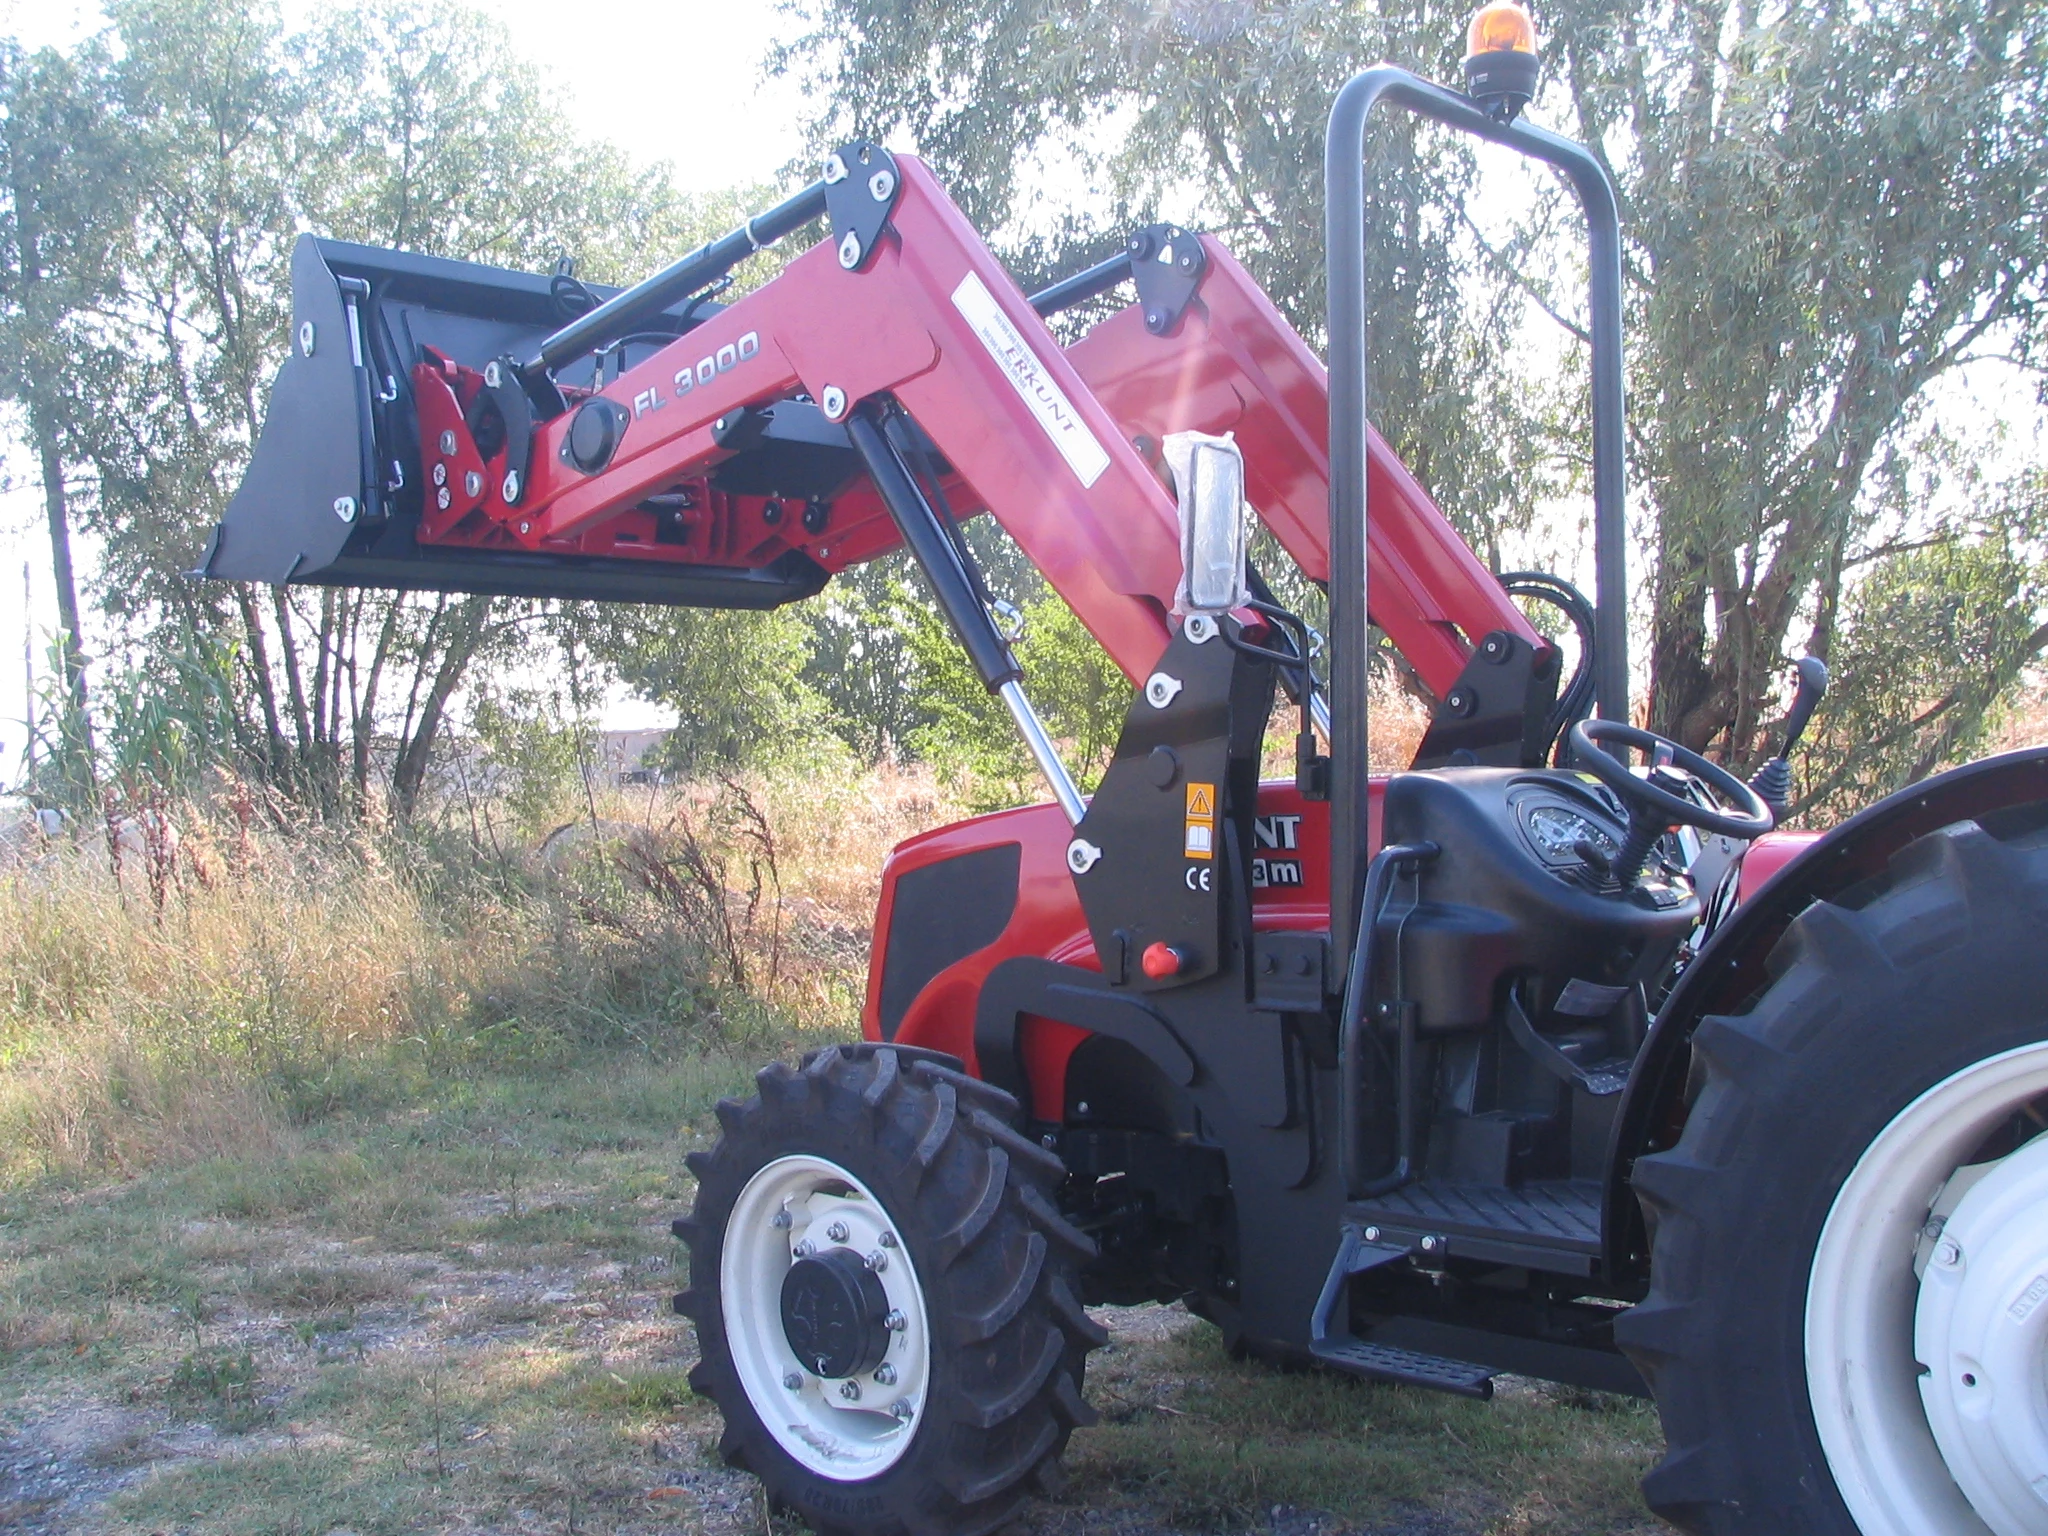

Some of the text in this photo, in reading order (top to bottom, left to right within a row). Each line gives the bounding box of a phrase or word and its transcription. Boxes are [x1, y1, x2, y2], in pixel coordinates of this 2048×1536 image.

[633, 330, 761, 420] FL 3000
[1007, 346, 1076, 432] ERKUNT
[1186, 866, 1211, 891] CE
